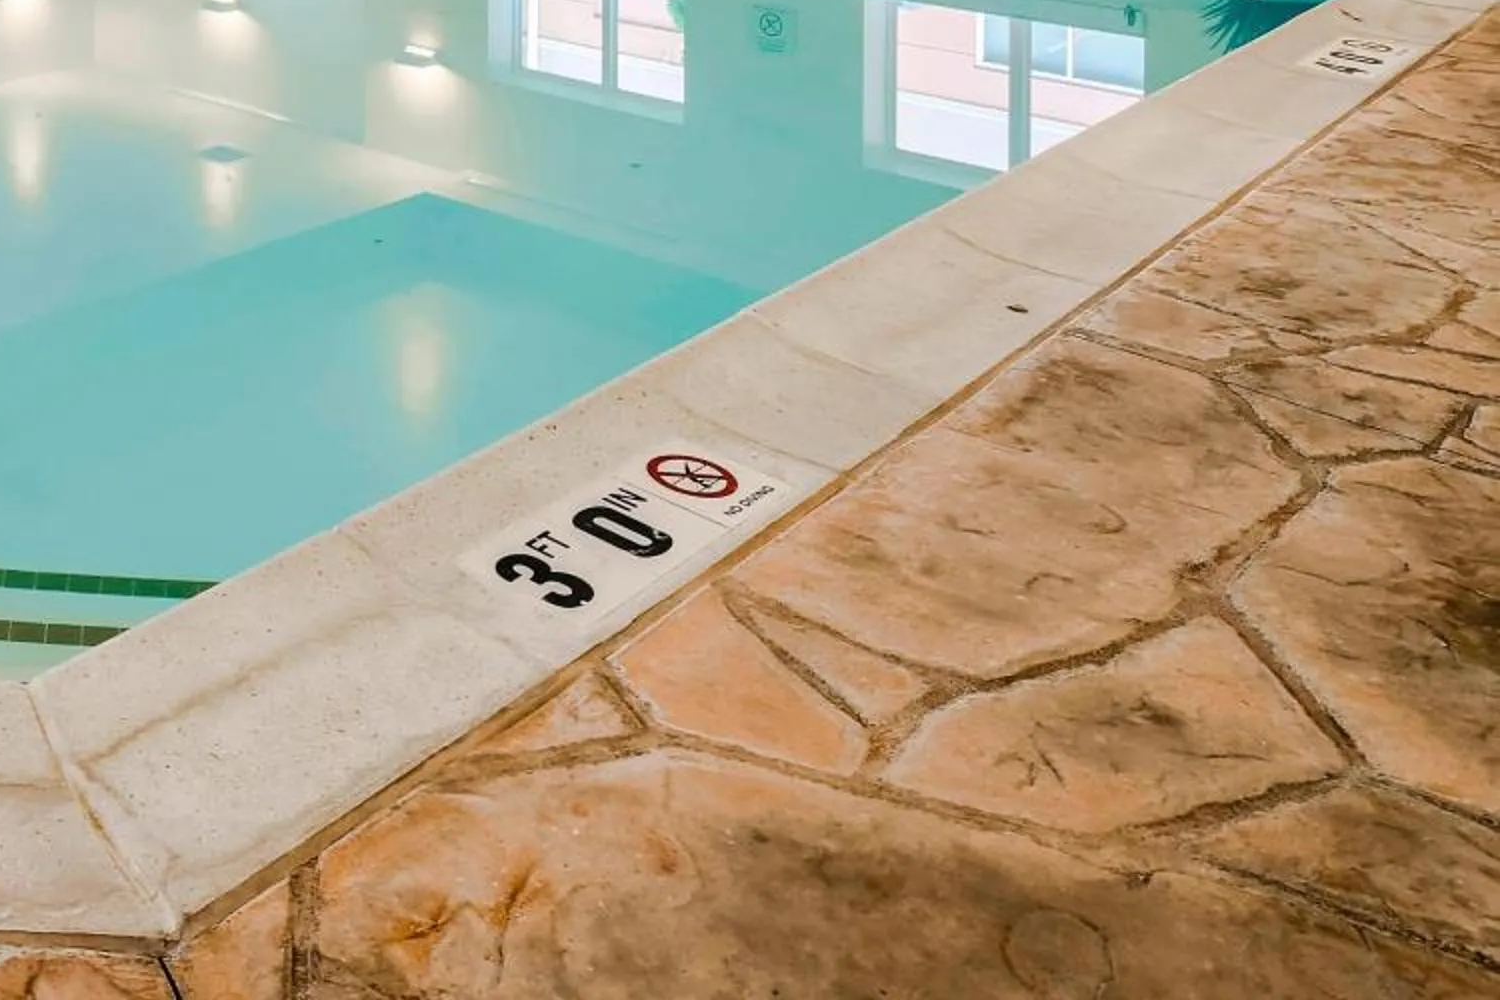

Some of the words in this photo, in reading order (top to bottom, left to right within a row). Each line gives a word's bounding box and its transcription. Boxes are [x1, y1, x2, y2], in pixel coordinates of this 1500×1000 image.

[601, 487, 648, 512] IN
[724, 505, 744, 515] NO
[739, 485, 775, 506] DIVING
[525, 530, 571, 558] FT
[572, 506, 673, 558] 0
[495, 553, 595, 608] 3
